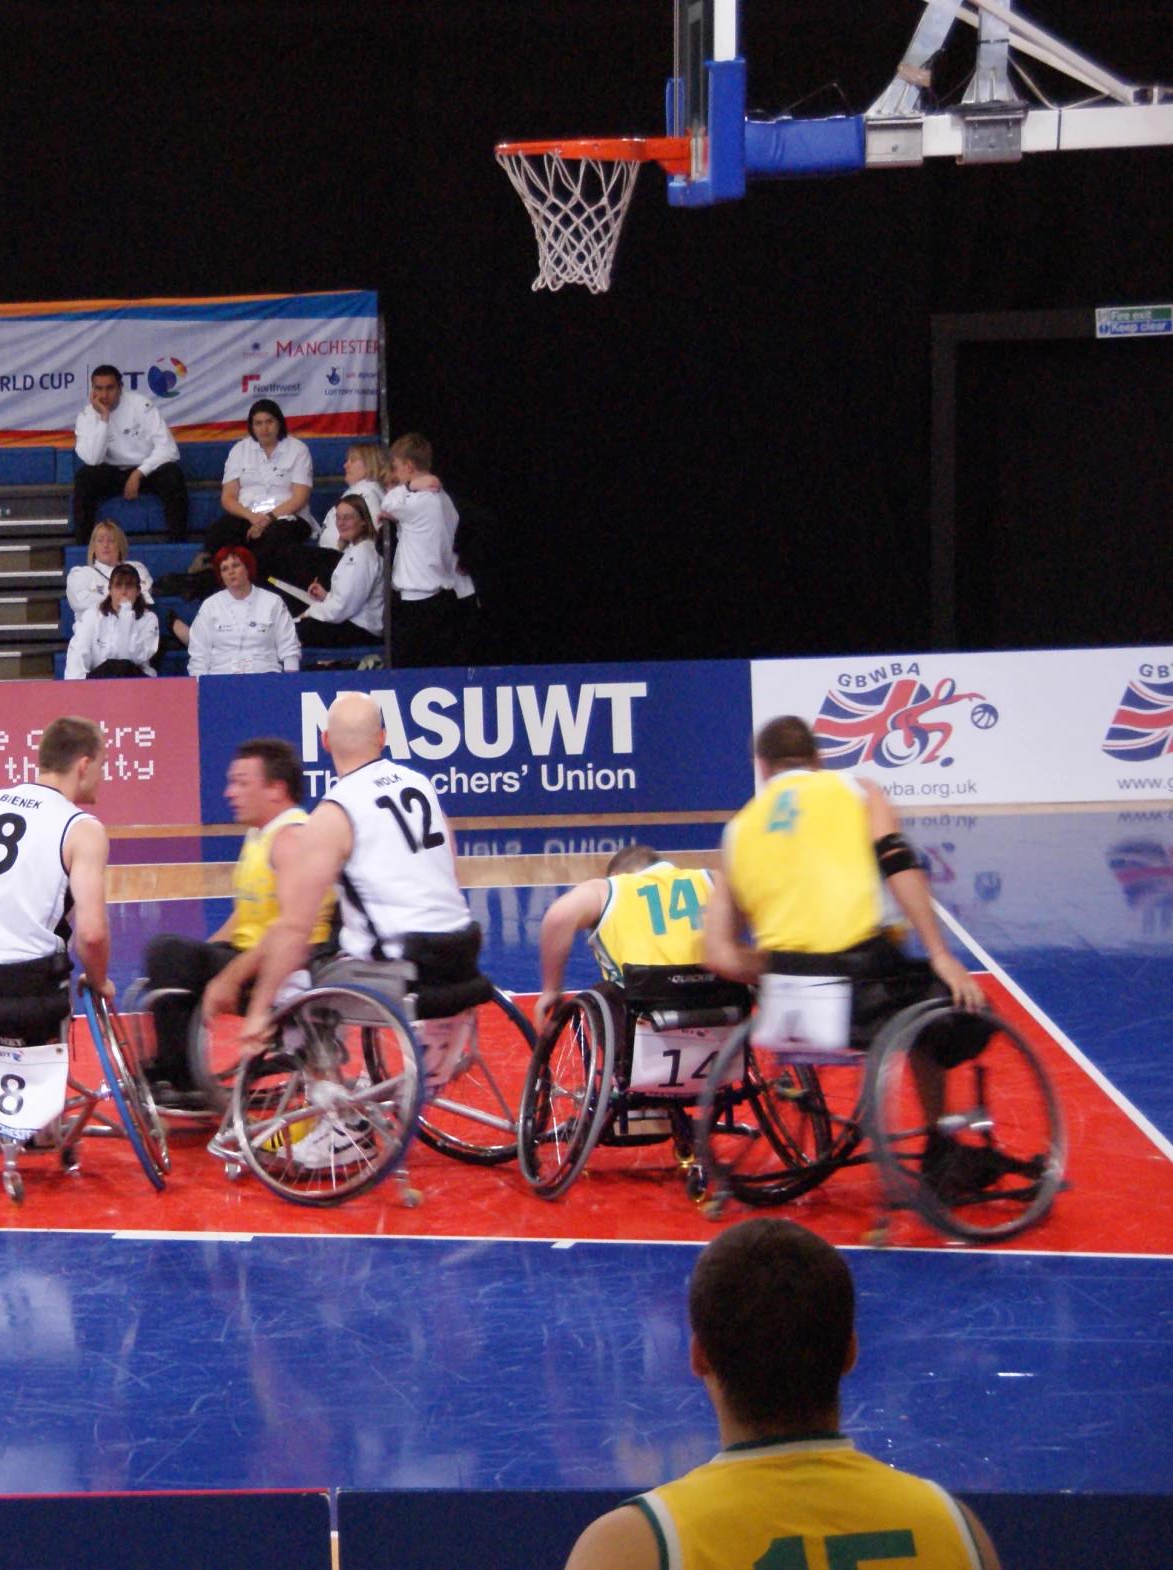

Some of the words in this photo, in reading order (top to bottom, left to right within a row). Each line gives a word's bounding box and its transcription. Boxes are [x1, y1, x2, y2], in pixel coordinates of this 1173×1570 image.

[39, 372, 76, 391] CUP
[118, 371, 145, 391] T
[253, 382, 301, 393] Northwest
[837, 662, 922, 688] GBWBA
[27, 721, 156, 750] ctre
[5, 755, 40, 784] th
[102, 753, 155, 781] ity
[302, 769, 340, 798] Th
[431, 764, 529, 795] chers'
[541, 764, 636, 793] Union
[0, 794, 43, 810] BIENEK
[879, 780, 977, 798] wba.org.uk
[375, 786, 445, 854] 12
[637, 878, 706, 935] 14
[658, 1048, 721, 1087] 14
